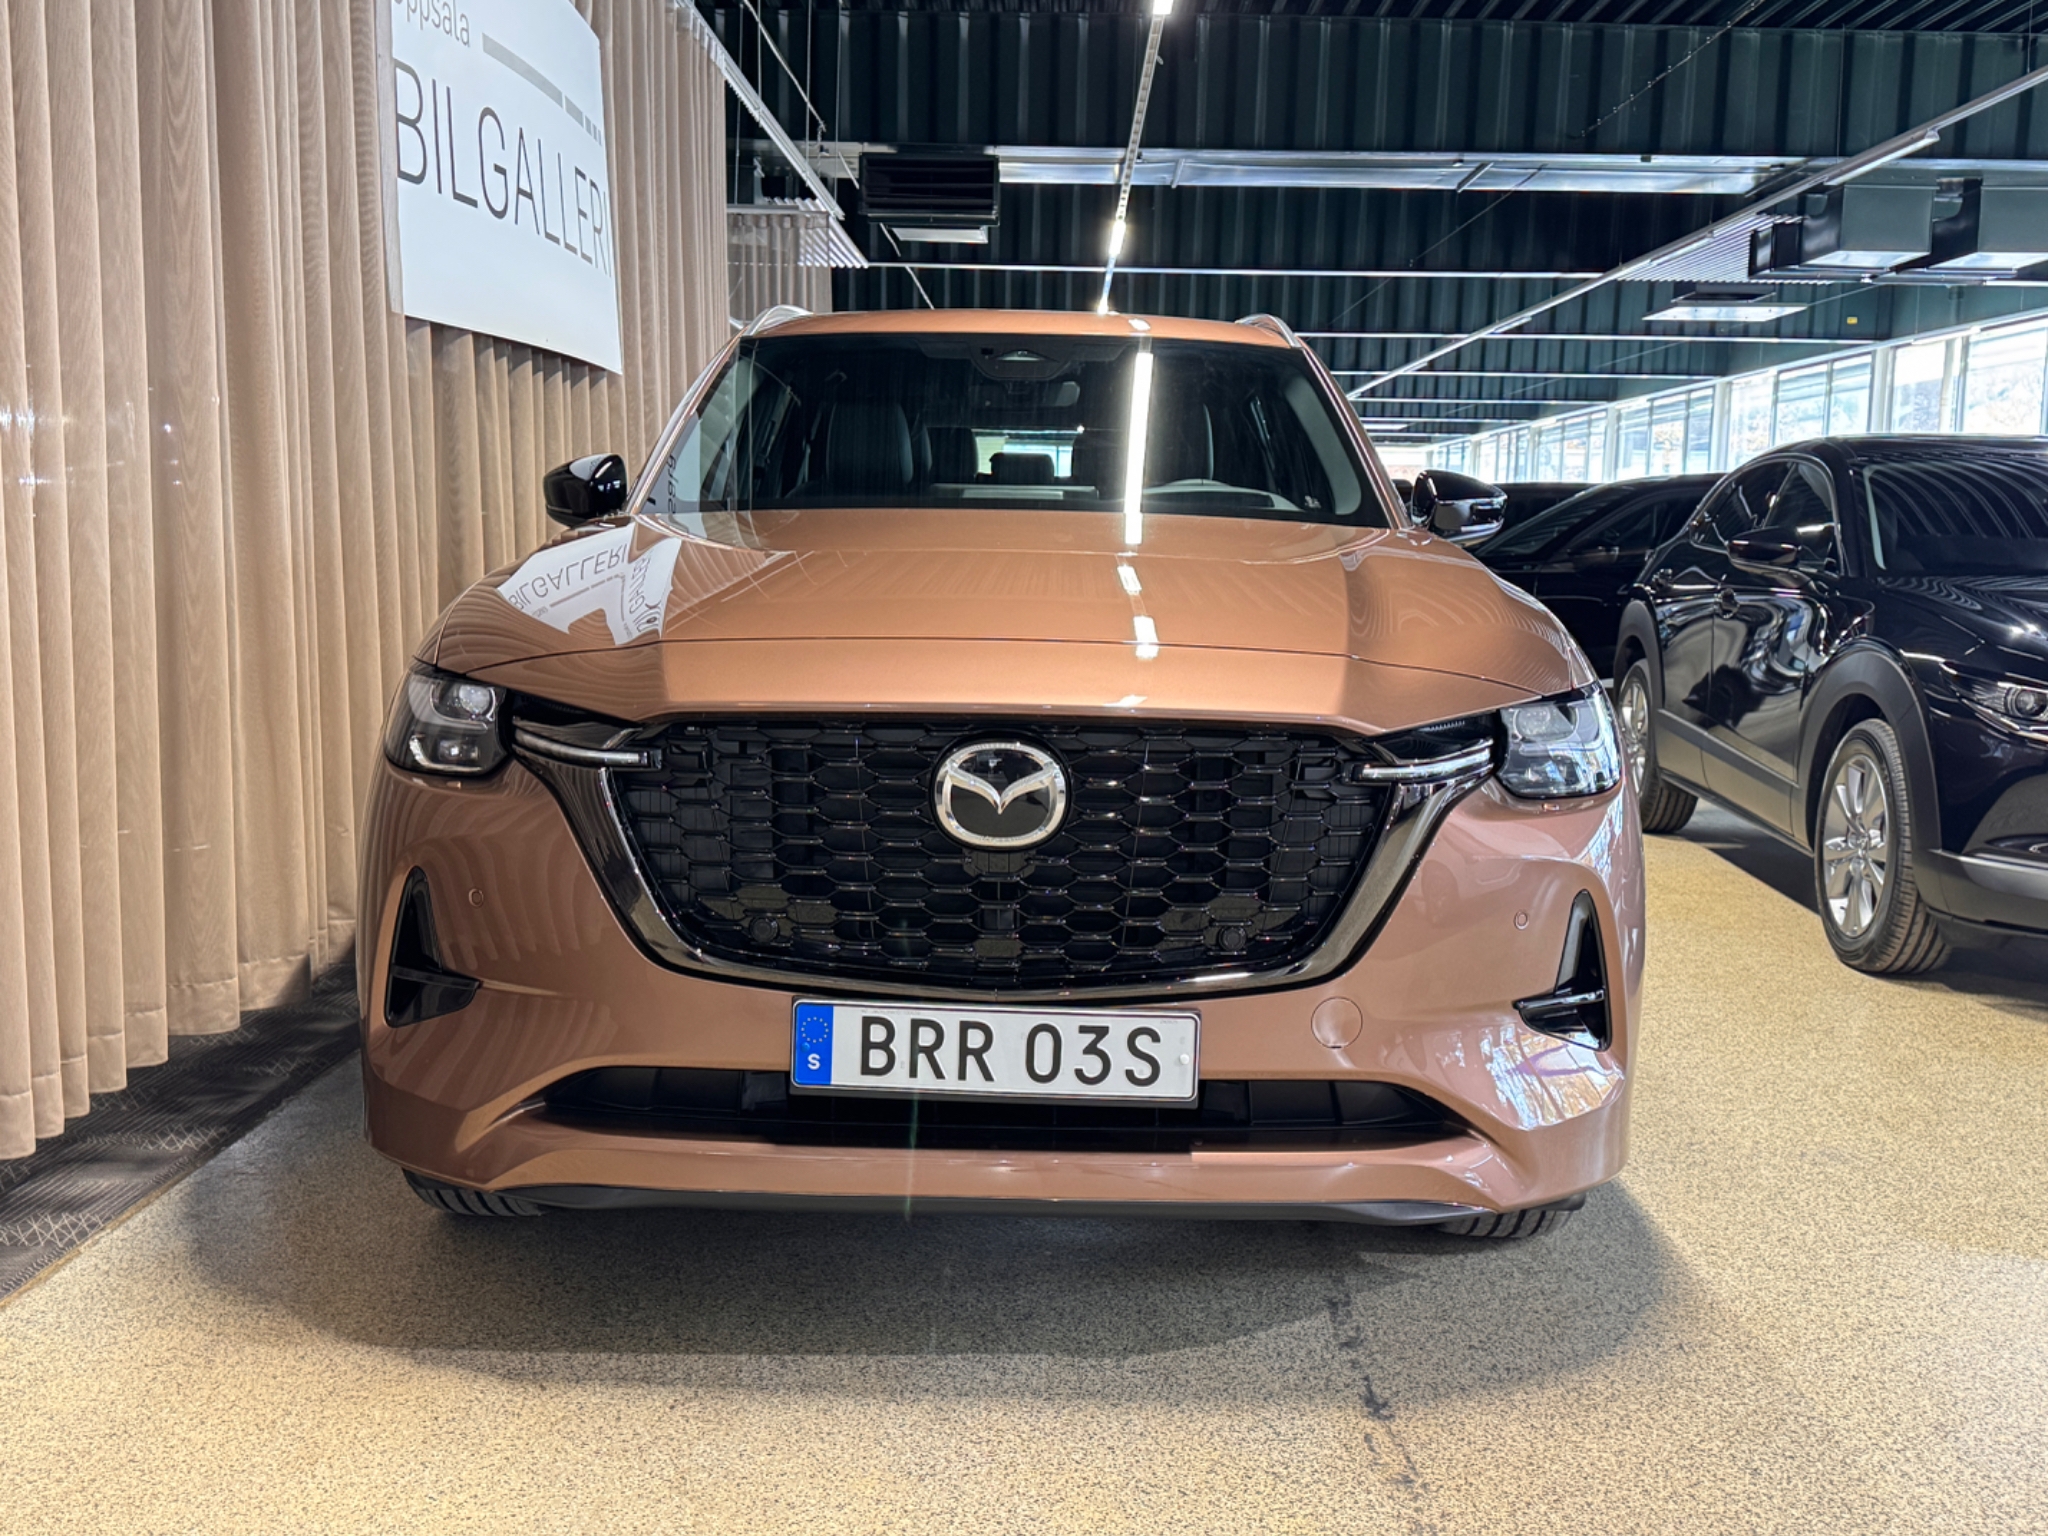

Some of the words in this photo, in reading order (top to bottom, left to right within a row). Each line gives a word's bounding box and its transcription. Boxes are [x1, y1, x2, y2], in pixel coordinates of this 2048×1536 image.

[394, 0, 471, 48] ppsala
[394, 57, 612, 278] BILGALLERI
[807, 1053, 821, 1071] S
[860, 1015, 995, 1082] BRR
[1025, 1022, 1162, 1088] 03S
